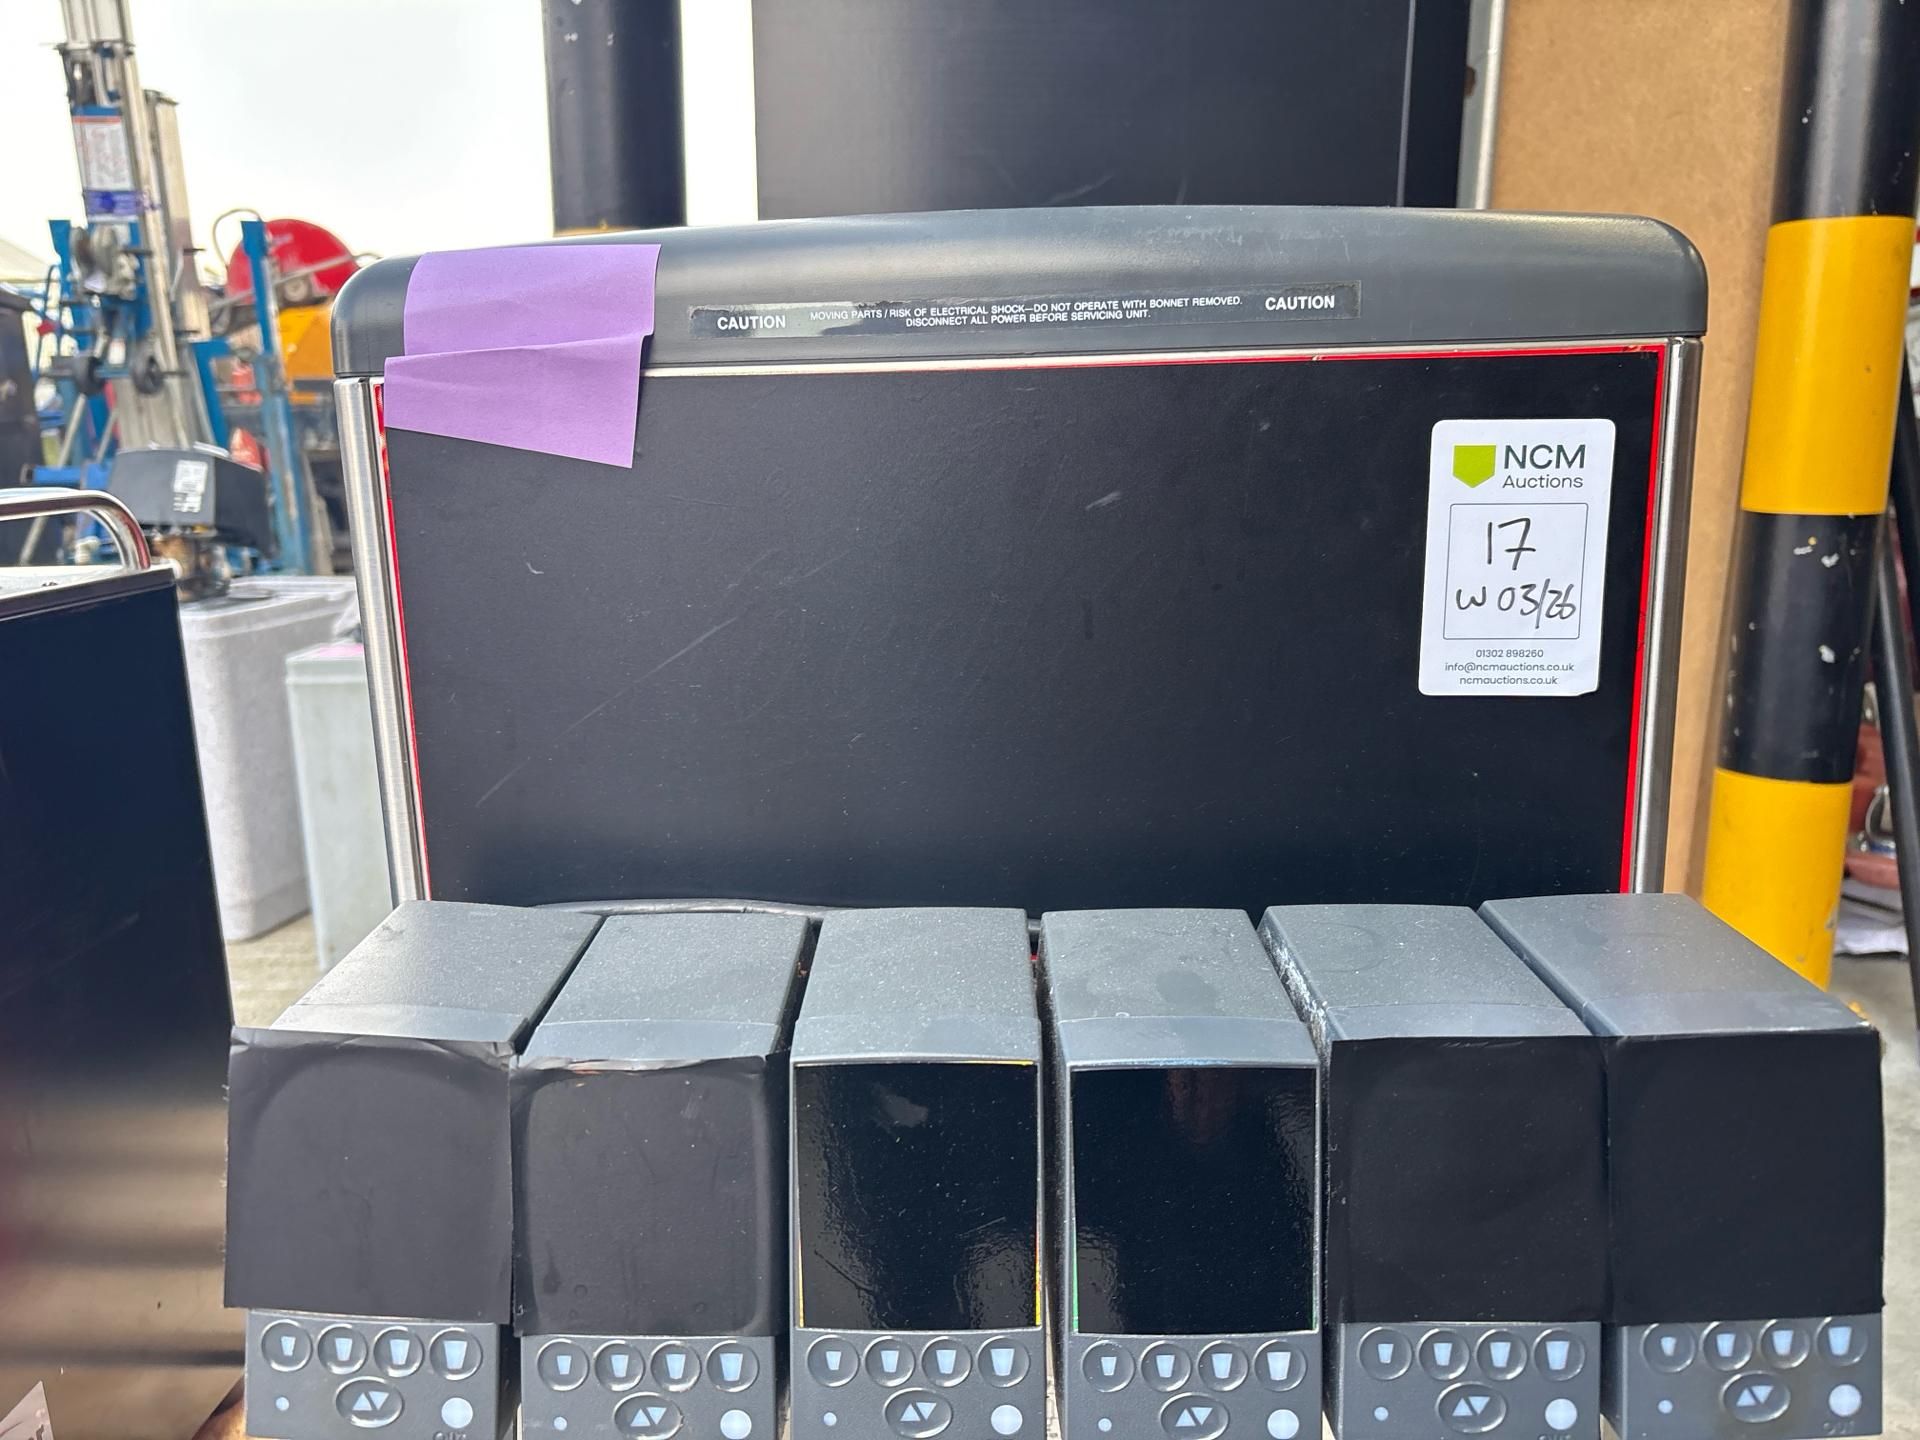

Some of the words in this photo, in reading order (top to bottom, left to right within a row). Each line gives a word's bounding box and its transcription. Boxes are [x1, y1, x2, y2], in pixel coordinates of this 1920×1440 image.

[810, 310, 849, 321] MOVING
[851, 309, 883, 319] PARTS
[889, 308, 912, 318] RISK
[914, 308, 928, 317] OF
[930, 305, 989, 317] ELECTRICAL
[1050, 302, 1071, 312] NOT
[1073, 300, 1119, 311] OPERATE
[1122, 299, 1147, 309] WITH
[1149, 297, 1190, 308] BONNET
[1192, 296, 1243, 307] REMOVED.
[1264, 295, 1335, 311] CAUTION
[716, 315, 787, 330] CAUTION
[905, 316, 968, 327] DISCONNECT
[970, 315, 988, 325] ALL
[991, 313, 1027, 324] POWER
[1029, 312, 1069, 323] BEFORE
[1070, 310, 1123, 321] SERVICING
[1125, 309, 1151, 319] UNIT.
[1503, 444, 1586, 470] NCM
[1502, 474, 1584, 489] Auctions
[1486, 517, 1536, 571] 17
[1475, 649, 1504, 659] 01302
[1506, 649, 1544, 659] 898260
[1445, 661, 1575, 673] info@ncmauctions.co.uk
[1459, 675, 1558, 686] ncmauctions.co.uk
